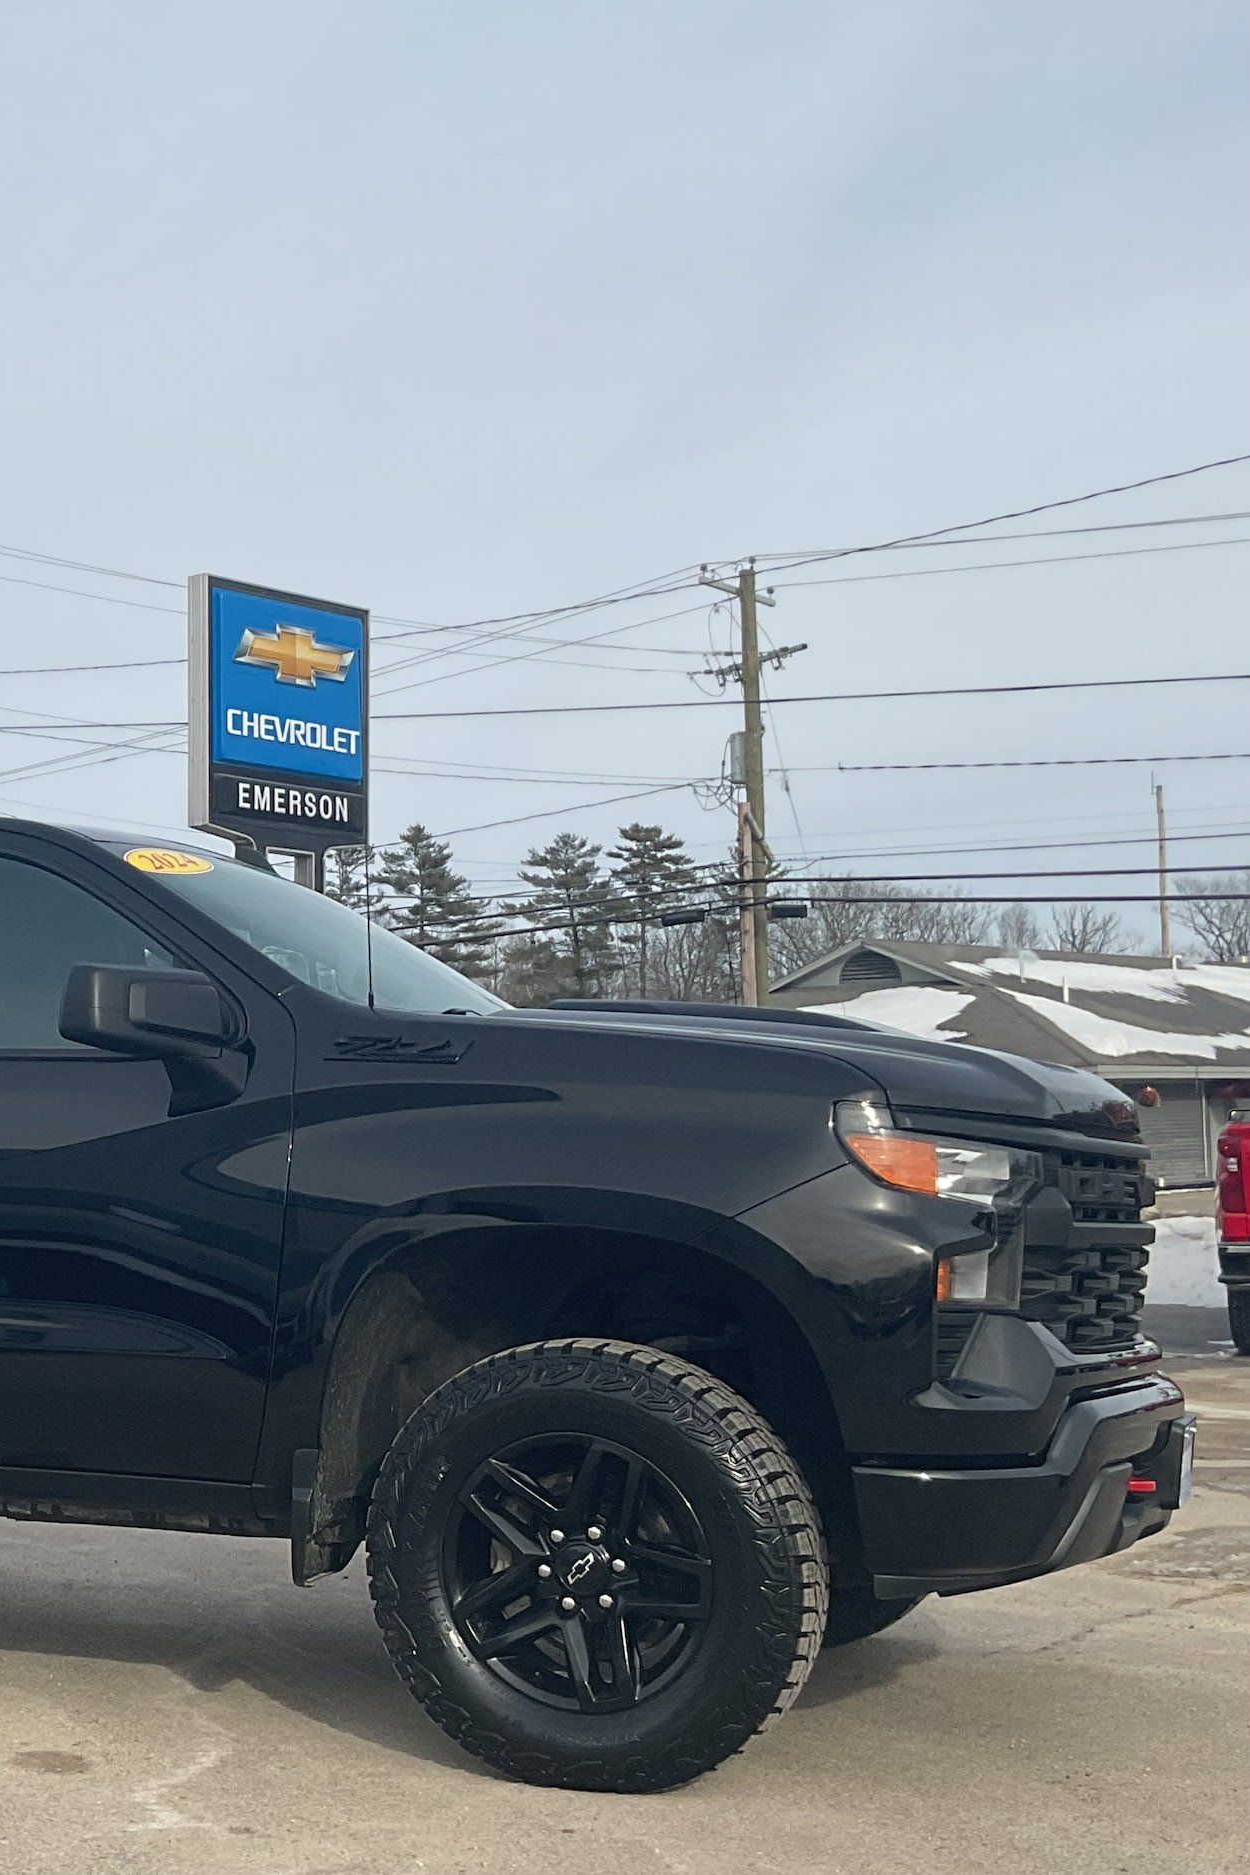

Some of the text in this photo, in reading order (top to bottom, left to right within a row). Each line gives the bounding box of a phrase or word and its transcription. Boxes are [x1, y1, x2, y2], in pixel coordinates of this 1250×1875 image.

[226, 708, 360, 755] CHEVROLET
[238, 782, 350, 823] EMERSON
[138, 852, 199, 870] 2024
